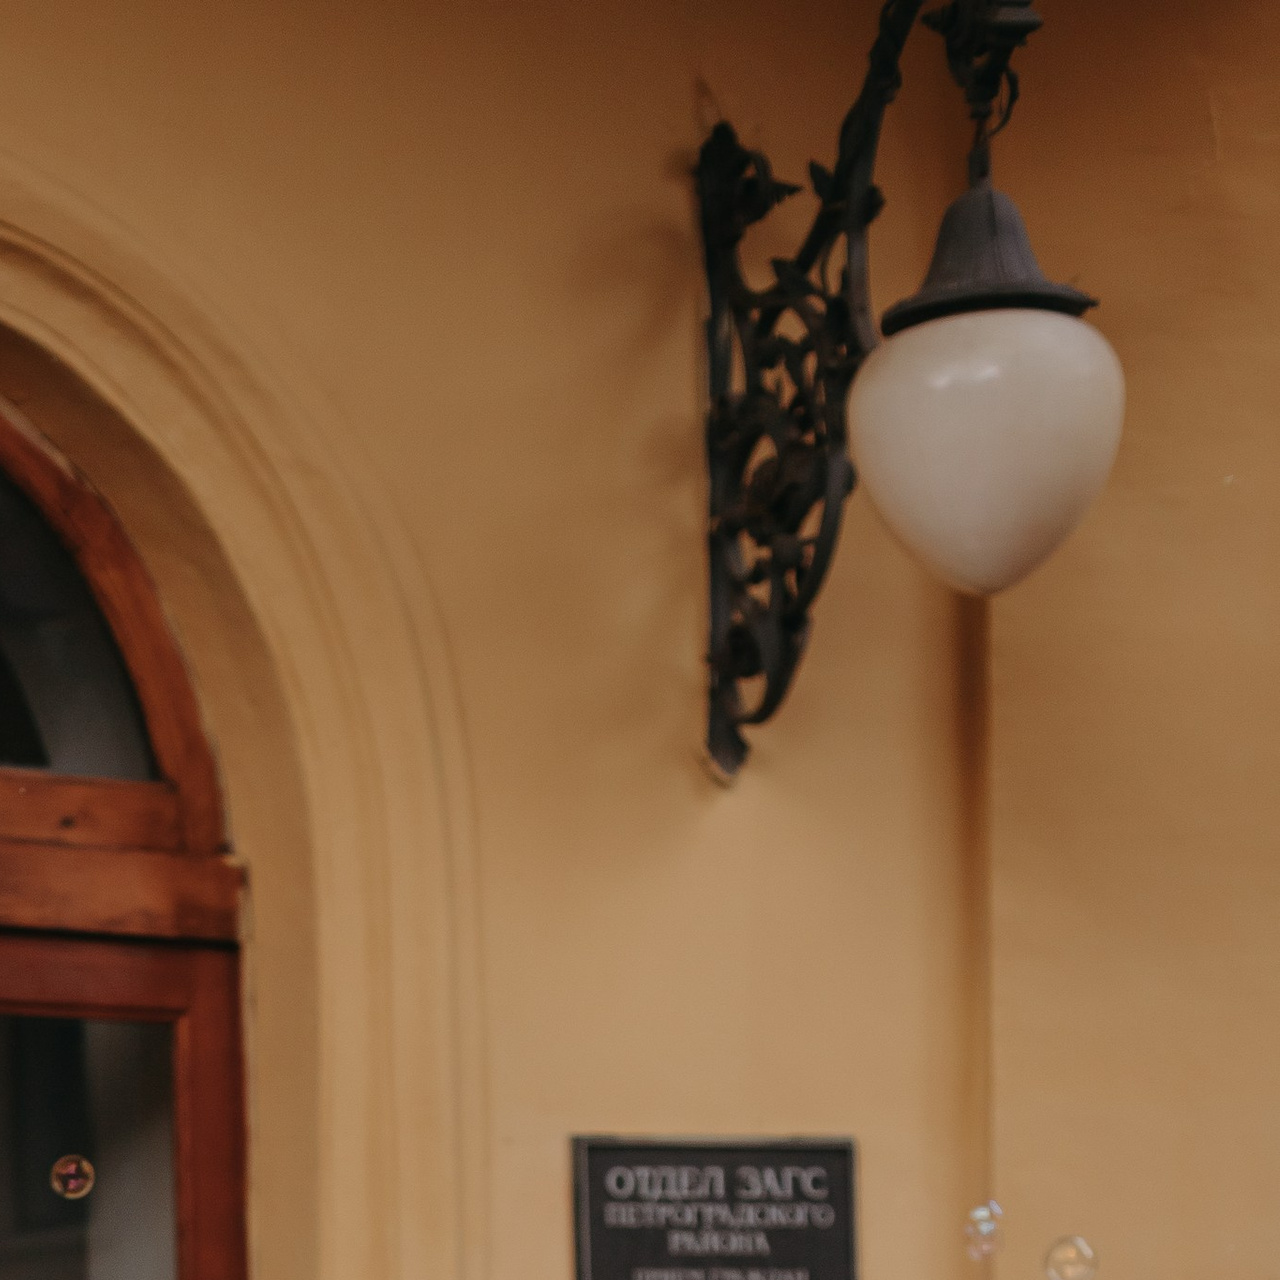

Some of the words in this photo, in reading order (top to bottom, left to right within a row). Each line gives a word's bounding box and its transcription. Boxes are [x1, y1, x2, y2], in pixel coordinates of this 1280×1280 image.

[604, 1165, 725, 1200] ОТДЕЛ
[734, 1165, 829, 1200] ЗАГС
[603, 1201, 836, 1230] ПЕТРОГРАДСКОГО
